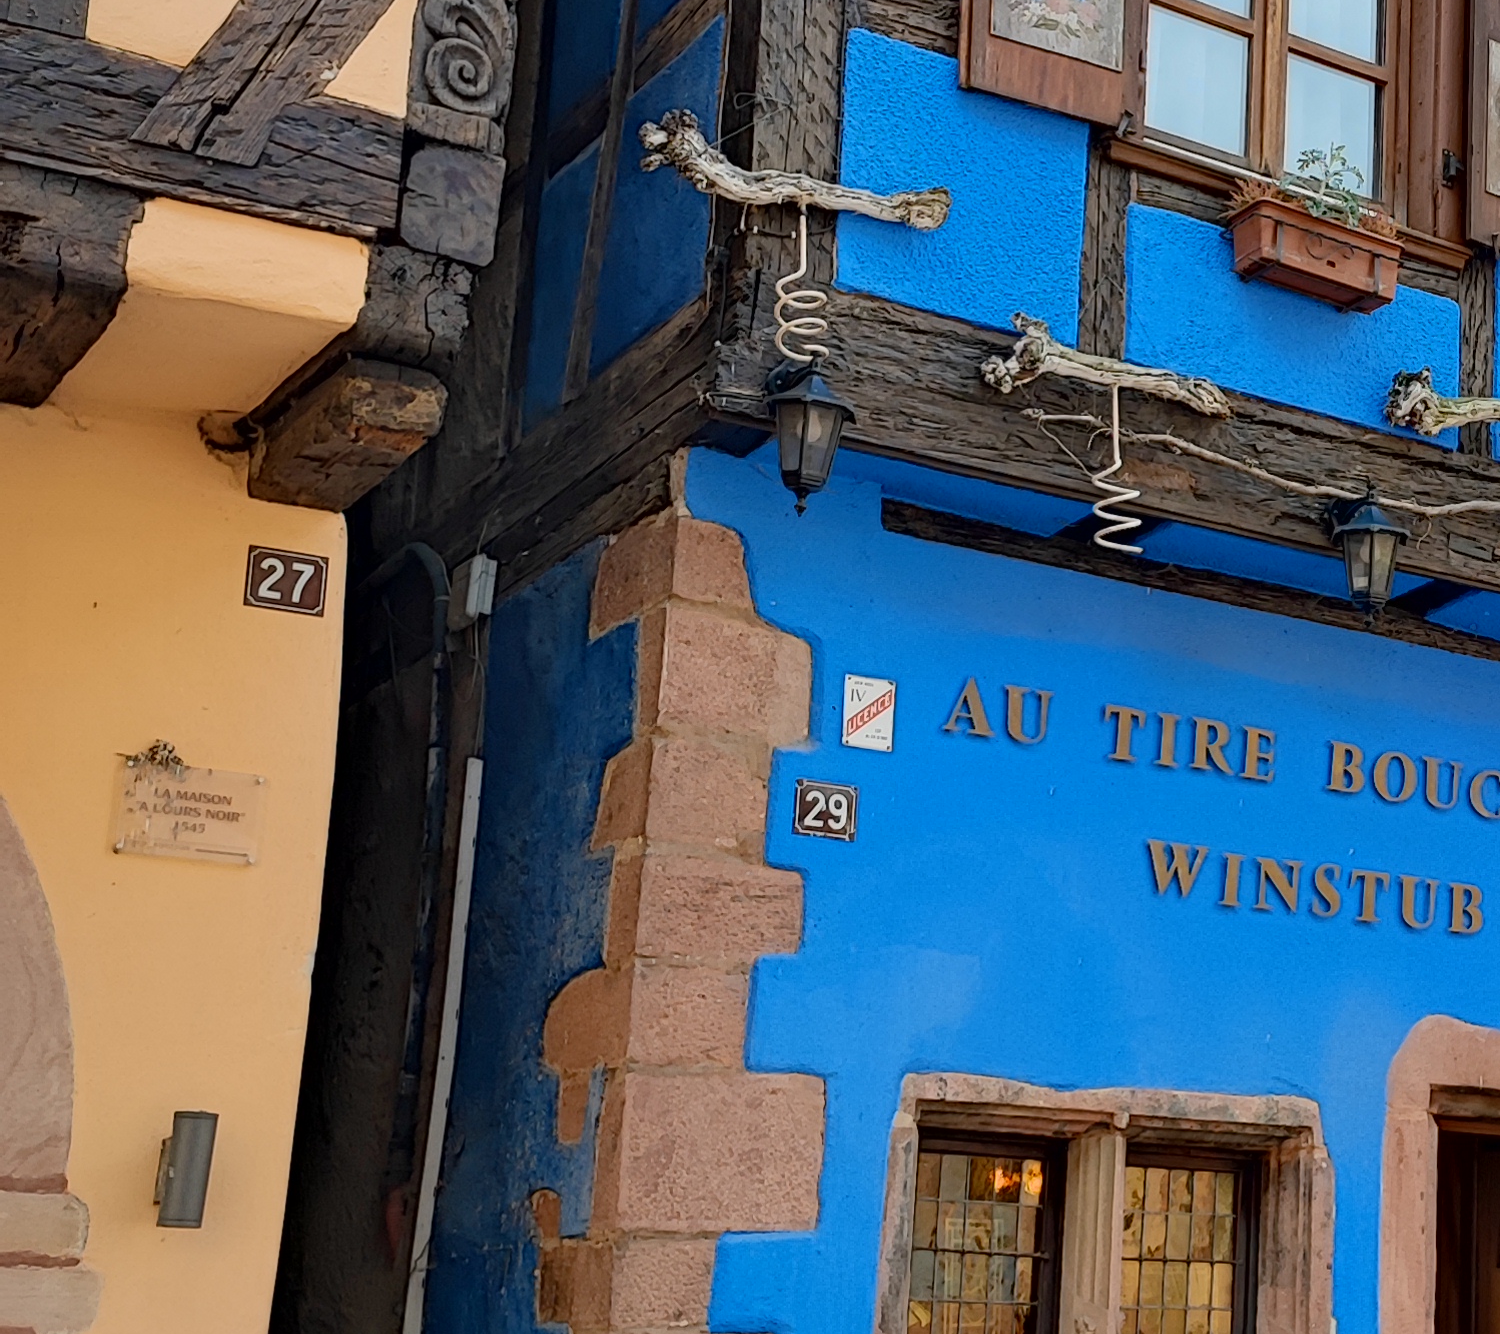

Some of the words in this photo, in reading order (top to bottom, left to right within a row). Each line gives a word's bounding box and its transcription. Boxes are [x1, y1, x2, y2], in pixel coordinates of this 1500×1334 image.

[257, 557, 315, 604] 27
[848, 691, 892, 734] LICENCE
[850, 688, 867, 703] IV
[943, 678, 1053, 745] AU
[1104, 703, 1276, 783] TIRE
[154, 787, 171, 799] LA
[175, 789, 233, 806] MAISON
[803, 789, 848, 831] 29
[1147, 838, 1485, 935] WINSTUB
